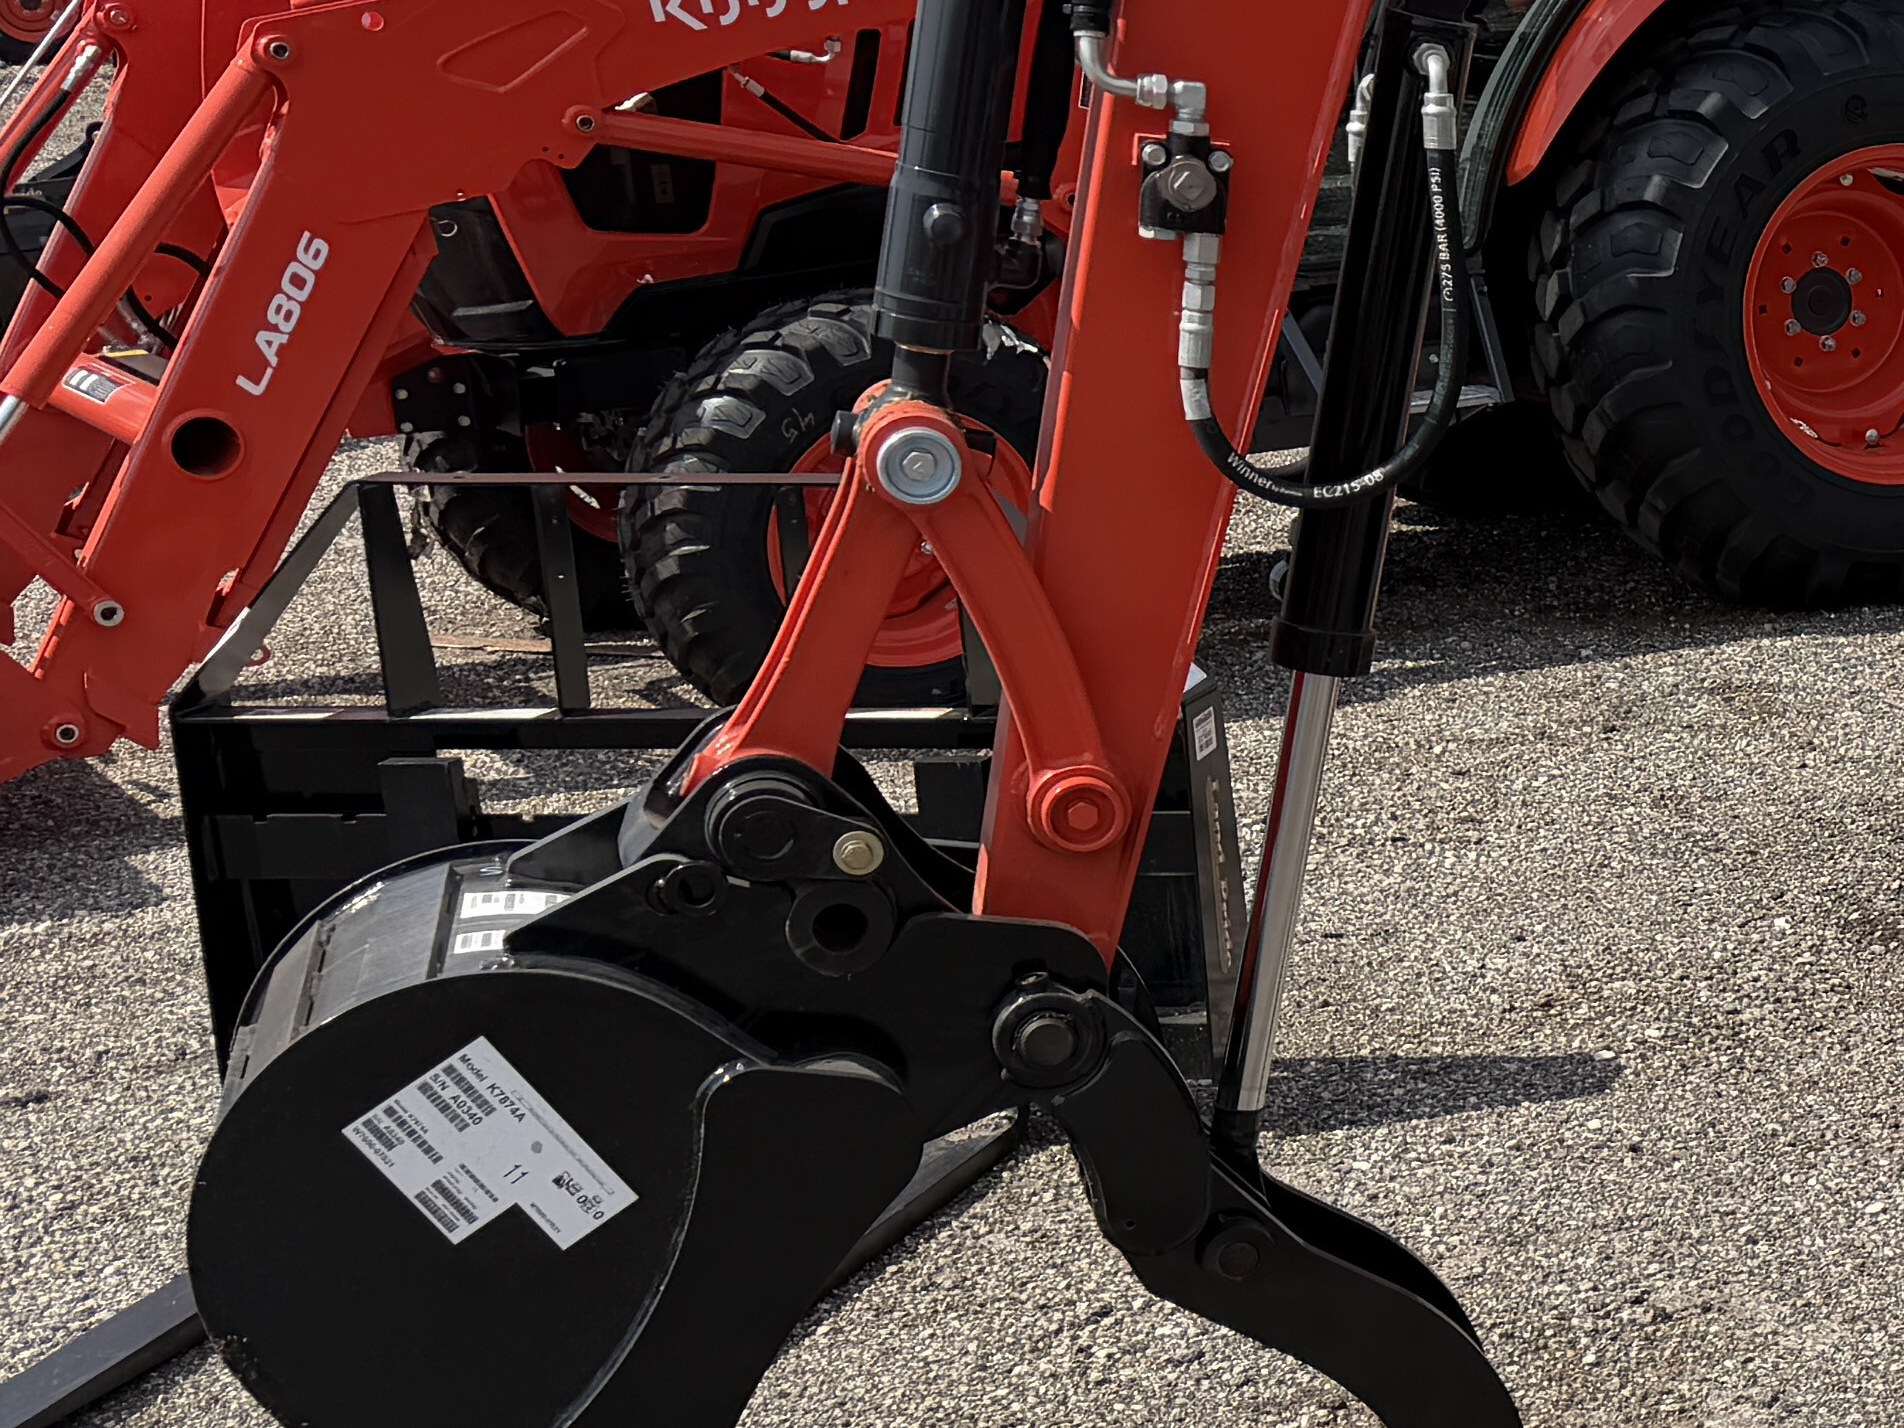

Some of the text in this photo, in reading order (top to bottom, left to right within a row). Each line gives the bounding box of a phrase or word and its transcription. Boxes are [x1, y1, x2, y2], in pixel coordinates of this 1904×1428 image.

[1428, 167, 1442, 192] PSI)
[1437, 233, 1451, 260] BAR
[234, 231, 330, 398] LA806
[1226, 451, 1274, 491] Winner
[457, 1052, 489, 1082] Model
[428, 1072, 484, 1126] S/N A0340
